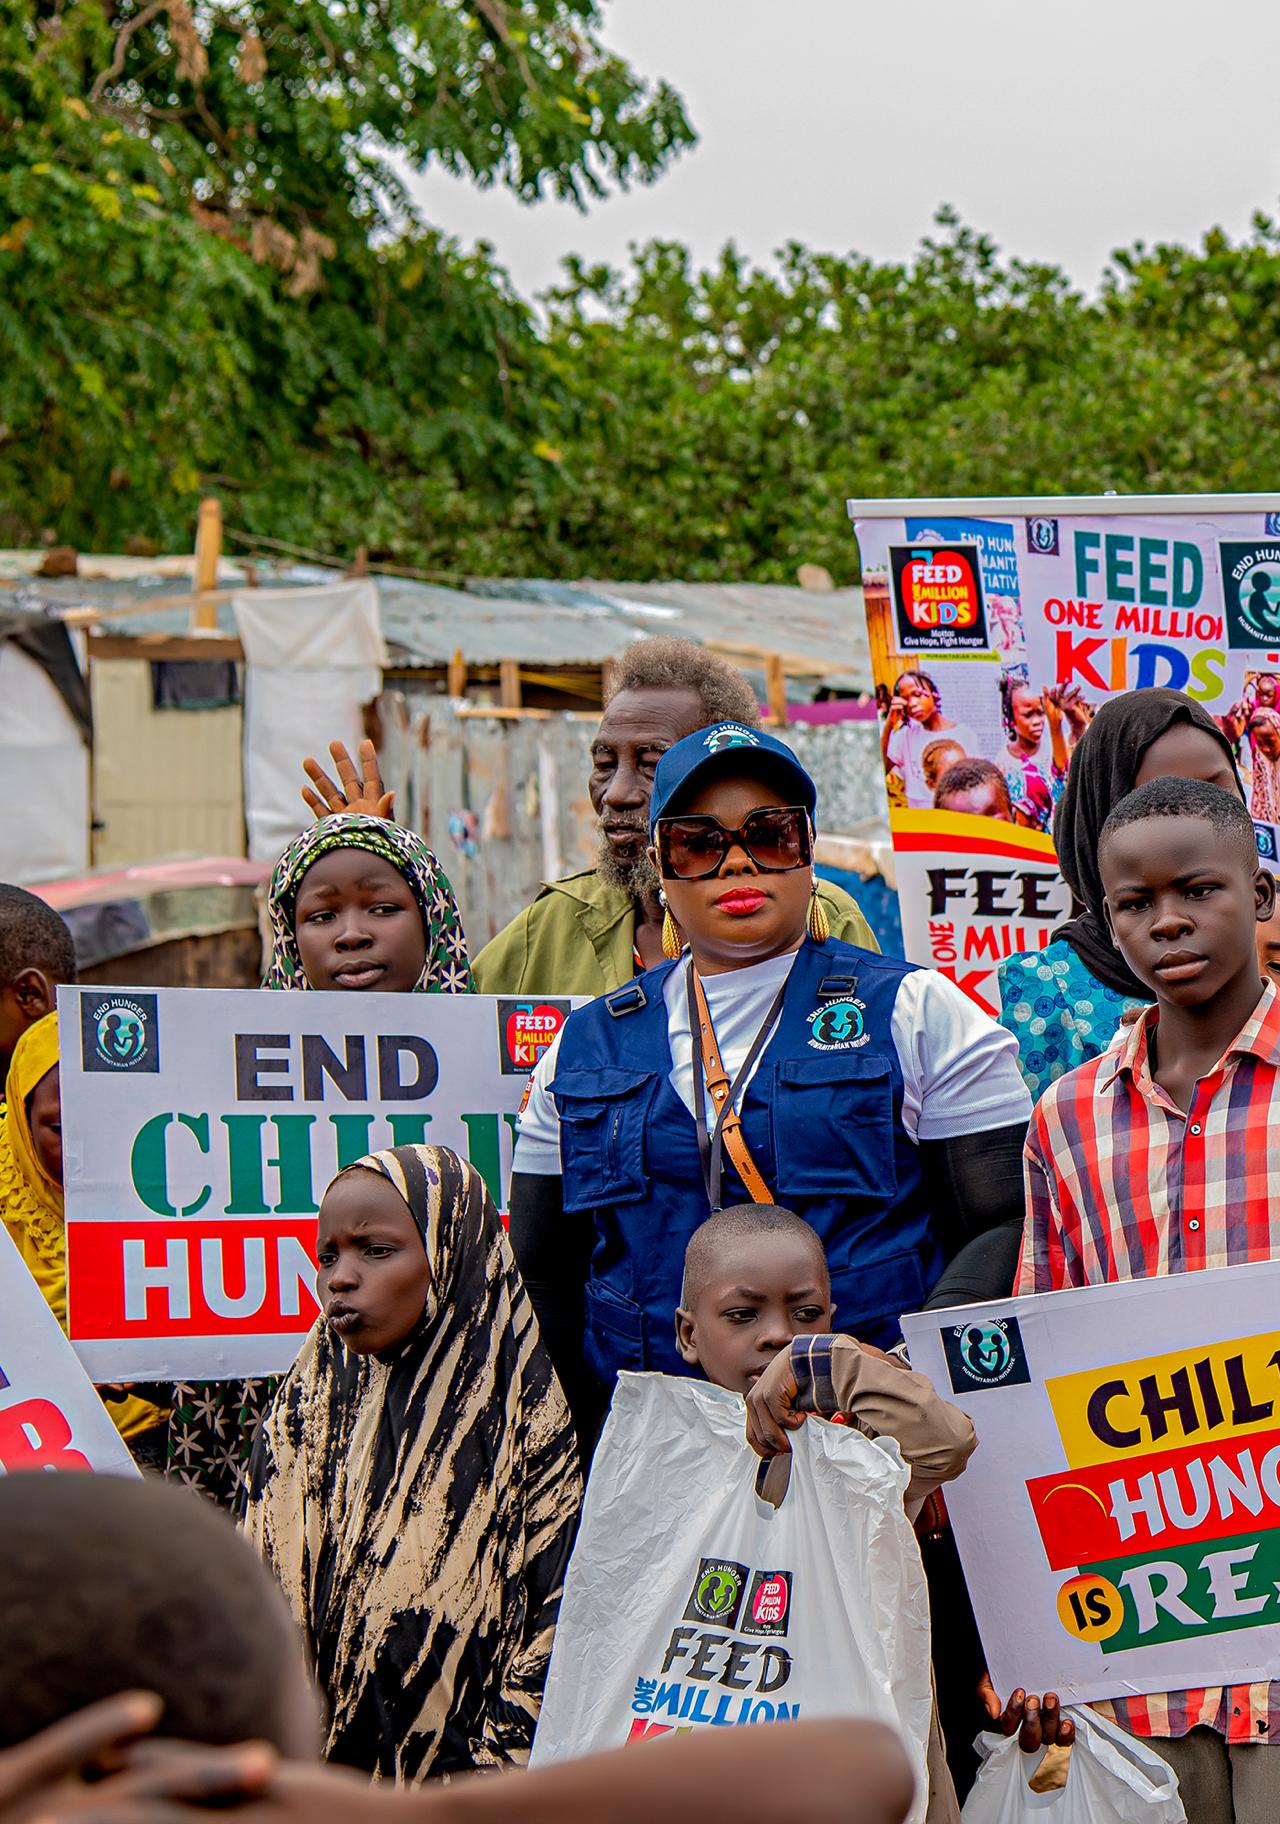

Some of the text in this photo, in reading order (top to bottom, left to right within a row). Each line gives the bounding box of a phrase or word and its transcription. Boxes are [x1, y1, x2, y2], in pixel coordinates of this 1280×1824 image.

[912, 565, 962, 583] FEED
[1074, 531, 1203, 608] FEED
[1232, 555, 1254, 581] END
[921, 585, 968, 600] MILLION
[913, 602, 971, 624] KIDS
[1044, 599, 1103, 631] ONE
[1056, 631, 1226, 702] KIDS
[926, 868, 1088, 920] FEE
[928, 920, 957, 962] ONE
[93, 998, 148, 1022] END HUNGER
[516, 1015, 556, 1030] FEED
[522, 1032, 556, 1043] MILLIO
[234, 1033, 440, 1101] END
[701, 1566, 715, 1579] END
[756, 1606, 780, 1621] KIDS
[1067, 1587, 1111, 1631] IS
[661, 1626, 794, 1693] FEED
[631, 1676, 657, 1713] ONE
